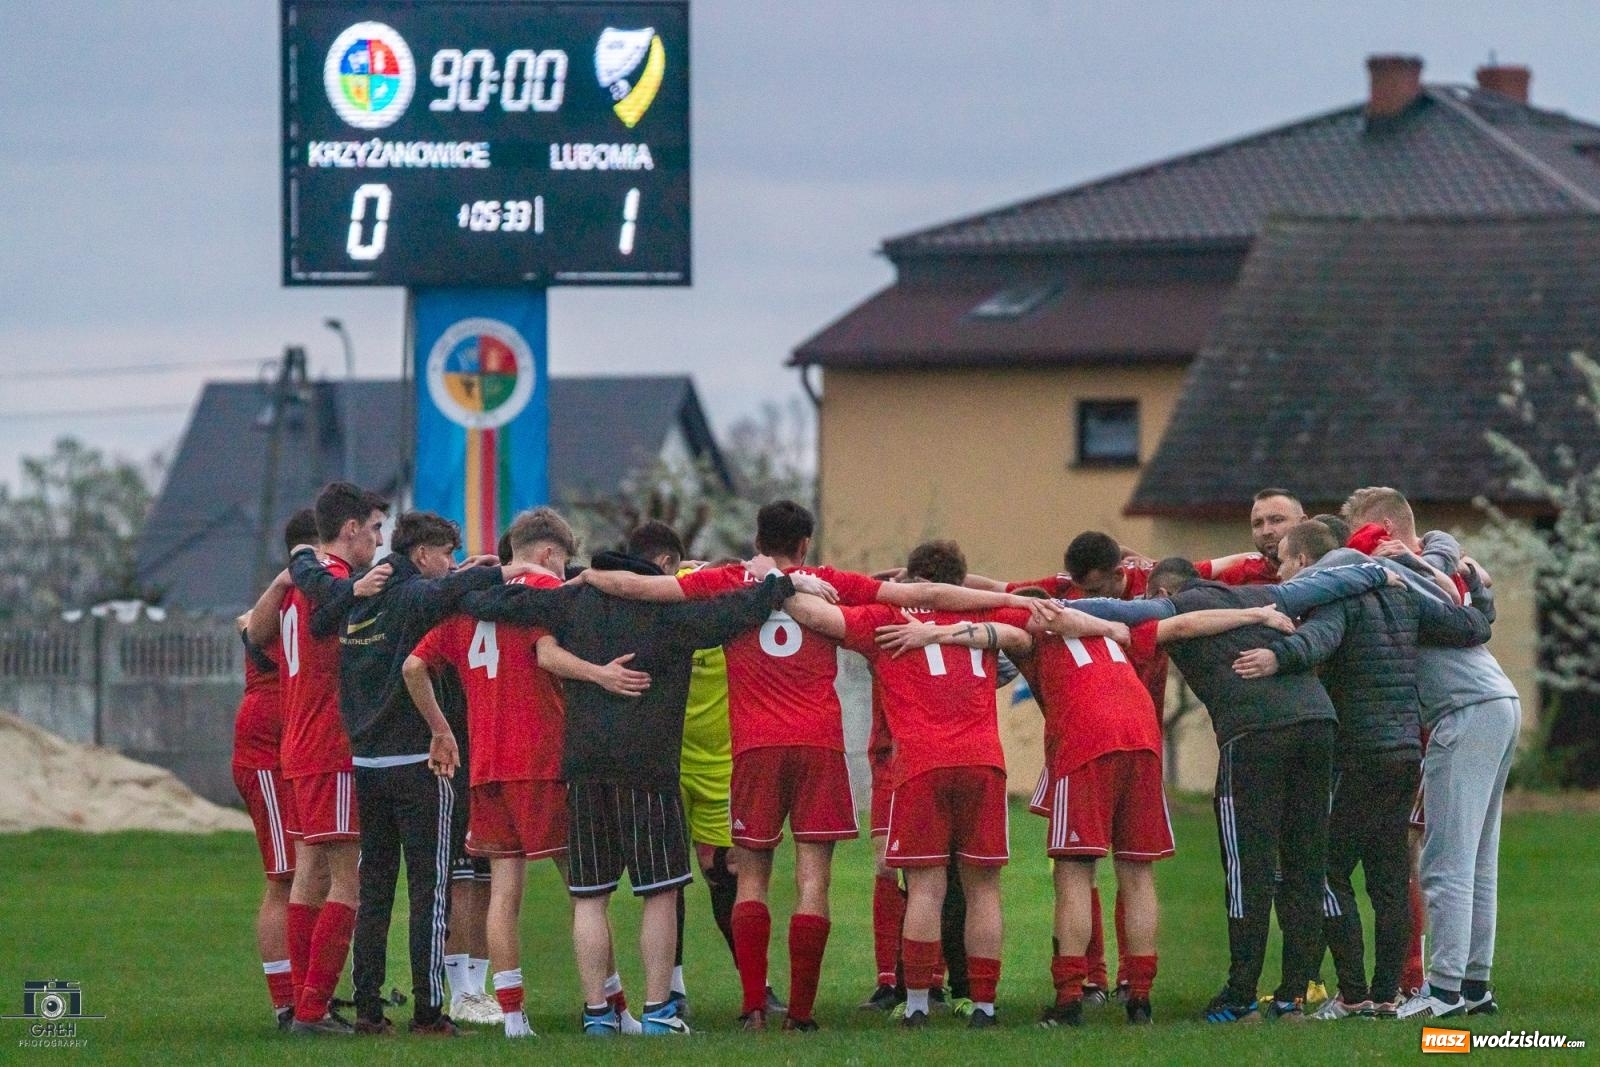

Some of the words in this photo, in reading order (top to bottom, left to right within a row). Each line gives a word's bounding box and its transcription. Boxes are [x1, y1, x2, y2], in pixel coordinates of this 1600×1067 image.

[429, 48, 569, 112] 90:00
[307, 137, 491, 169] KRZYŻANOWICE
[549, 142, 655, 171] LUBOMIA
[346, 183, 393, 261] 0
[618, 187, 641, 255] 1
[280, 603, 300, 678] 0
[467, 619, 500, 679] 4
